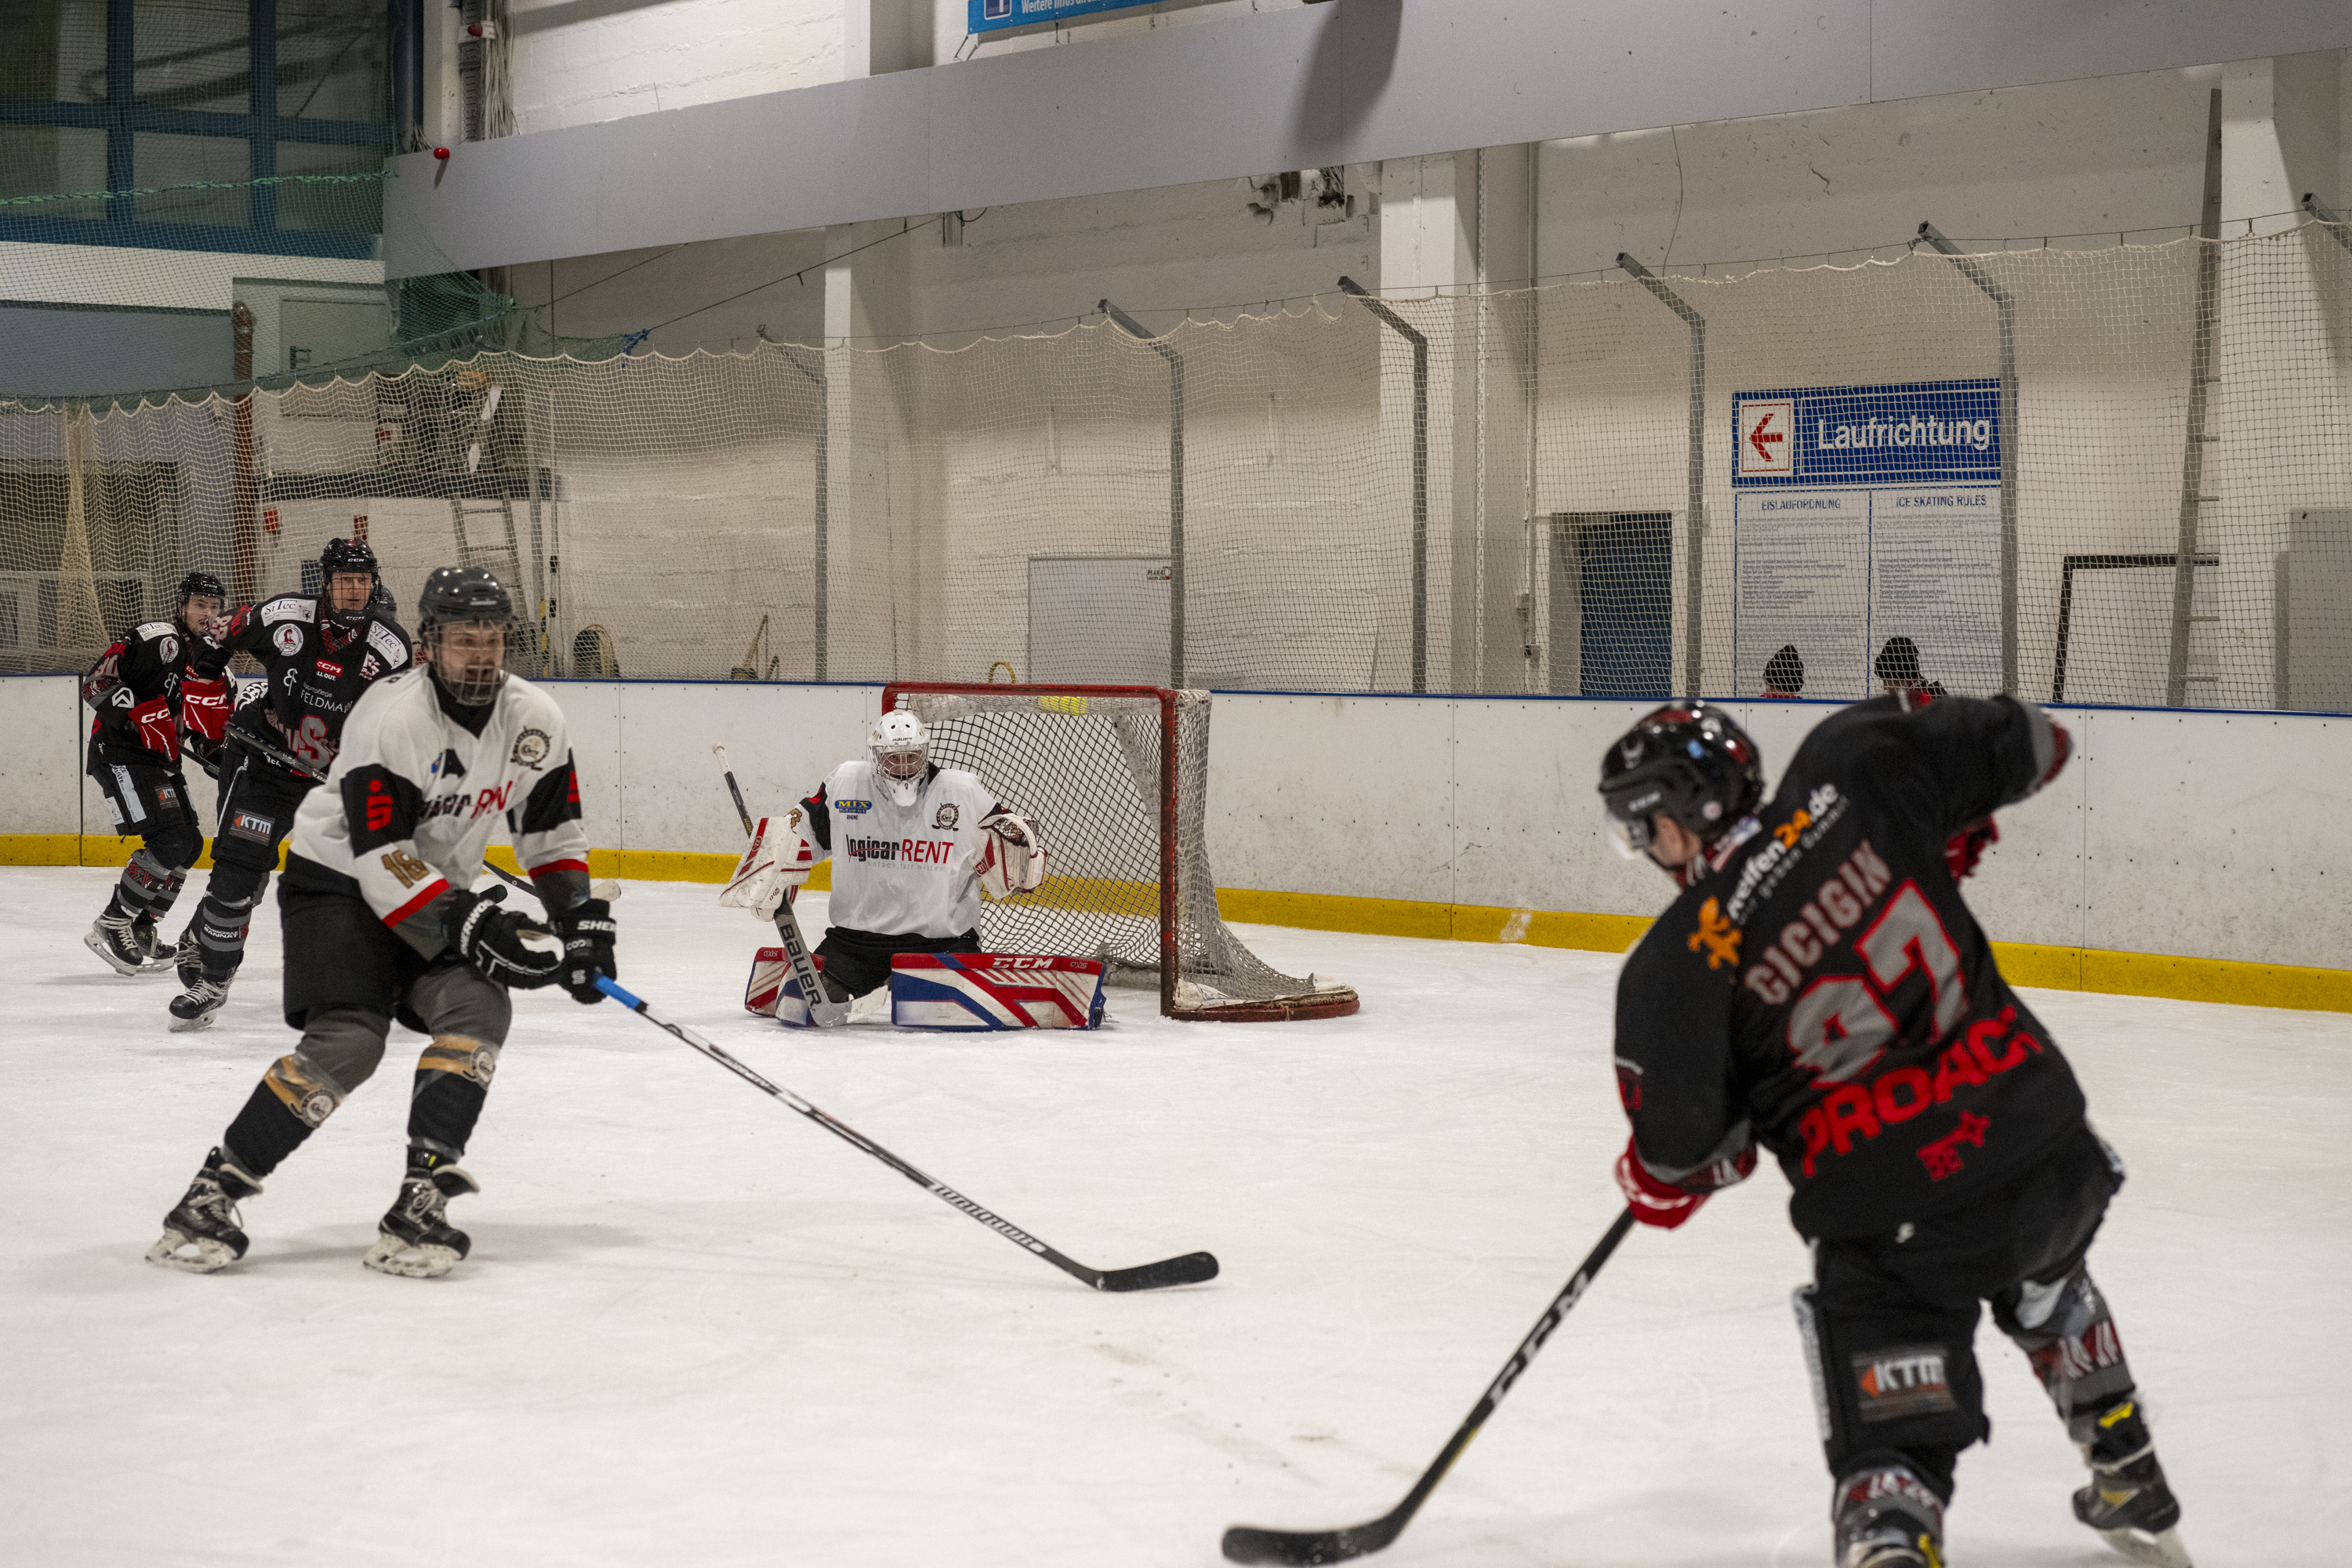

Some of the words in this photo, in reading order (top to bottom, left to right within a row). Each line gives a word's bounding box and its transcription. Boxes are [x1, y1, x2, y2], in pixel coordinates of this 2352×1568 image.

[1818, 415, 1990, 451] Laufrichtung
[1762, 499, 1841, 510] EISLAUFORDNUNG
[1896, 497, 1911, 506] ICE
[1914, 495, 1954, 506] SKATING
[1956, 495, 1987, 506] RULES
[264, 600, 298, 615] SiTec
[370, 622, 401, 649] SiTec
[317, 661, 342, 673] CCM
[141, 708, 171, 724] CC
[441, 749, 466, 779] A
[240, 815, 272, 835] KTM
[381, 849, 430, 889] 18
[779, 924, 822, 1008] BAUER
[992, 957, 1054, 969] CCM
